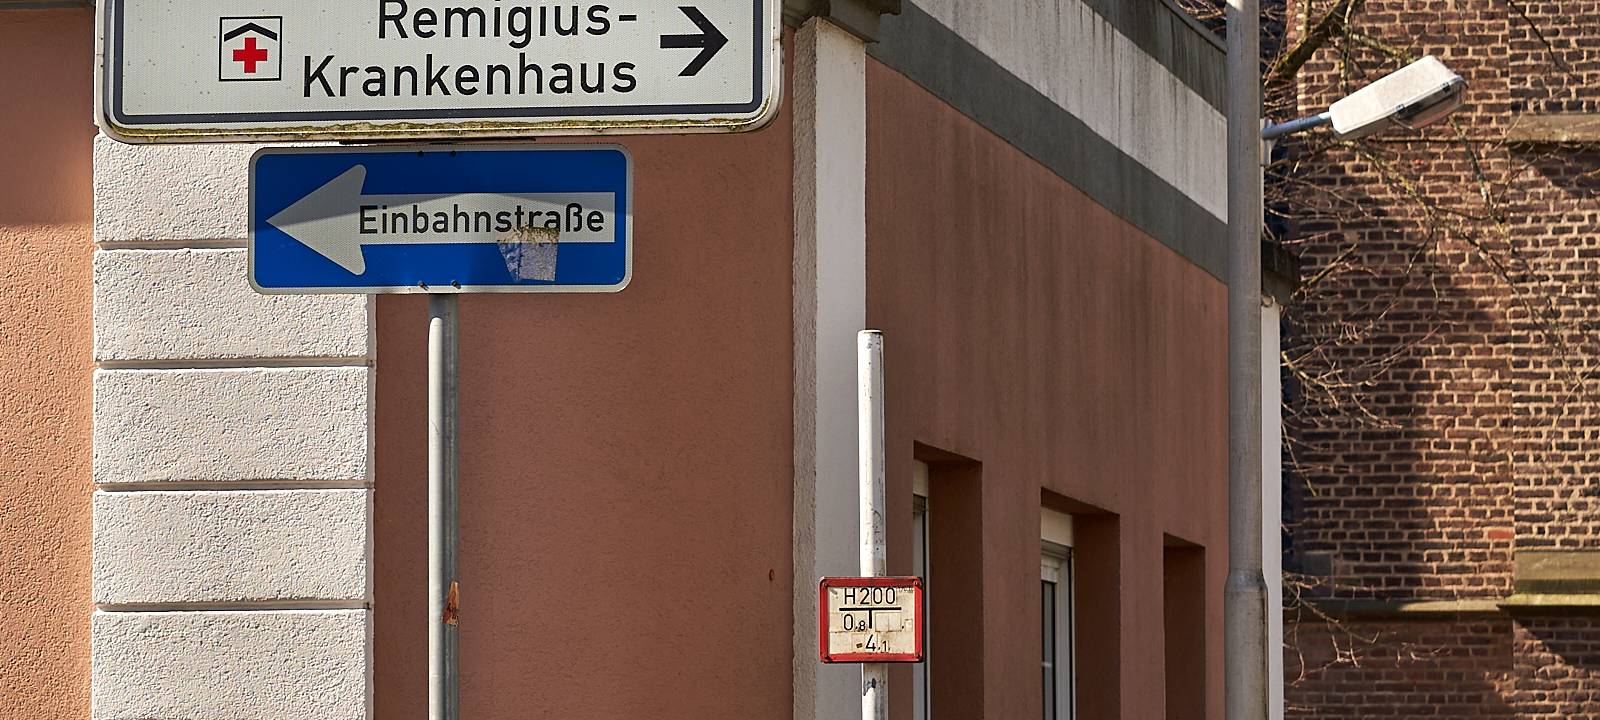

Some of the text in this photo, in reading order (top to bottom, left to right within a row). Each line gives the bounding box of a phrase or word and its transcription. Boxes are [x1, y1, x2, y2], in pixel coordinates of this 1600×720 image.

[378, 0, 637, 48] Remigius-
[303, 53, 637, 98] Krankenhaus
[358, 203, 605, 234] Einbahnstraße
